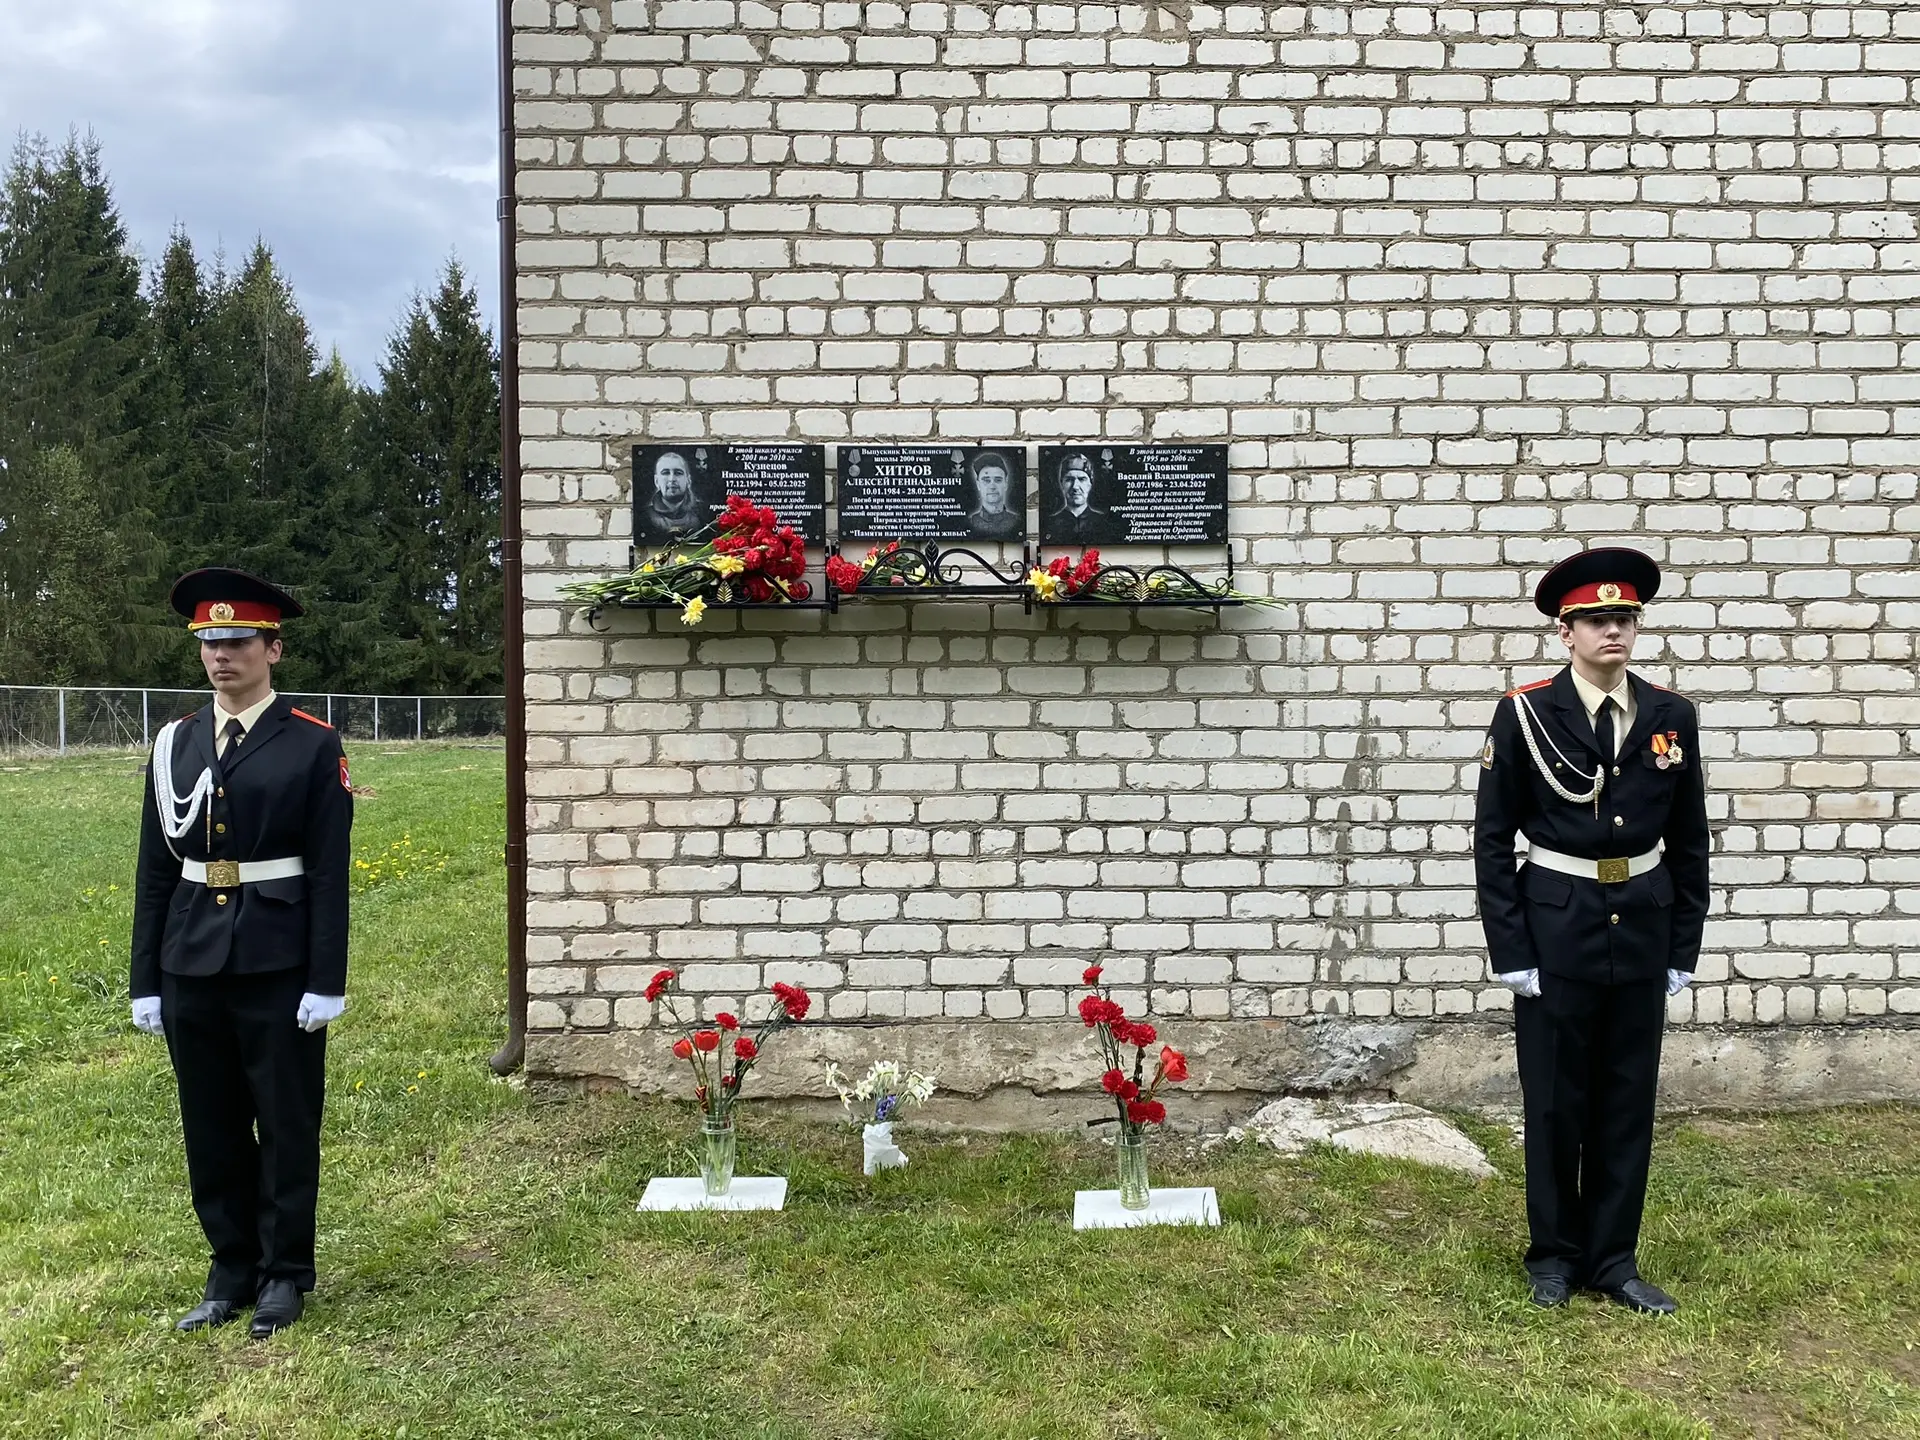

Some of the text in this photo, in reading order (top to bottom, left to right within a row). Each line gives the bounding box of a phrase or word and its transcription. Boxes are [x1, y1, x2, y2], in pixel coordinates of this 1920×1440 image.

[744, 462, 787, 471] Кузнецов
[875, 465, 932, 476] ХИТРОВ
[1145, 463, 1188, 471] Головкин
[761, 471, 809, 480] Валерьевич
[845, 477, 962, 486] АЛЕКСЕЙ ГЕННАДЬЕВИЧ
[1110, 504, 1149, 512] проведения
[1163, 533, 1209, 541] (посмертно).
